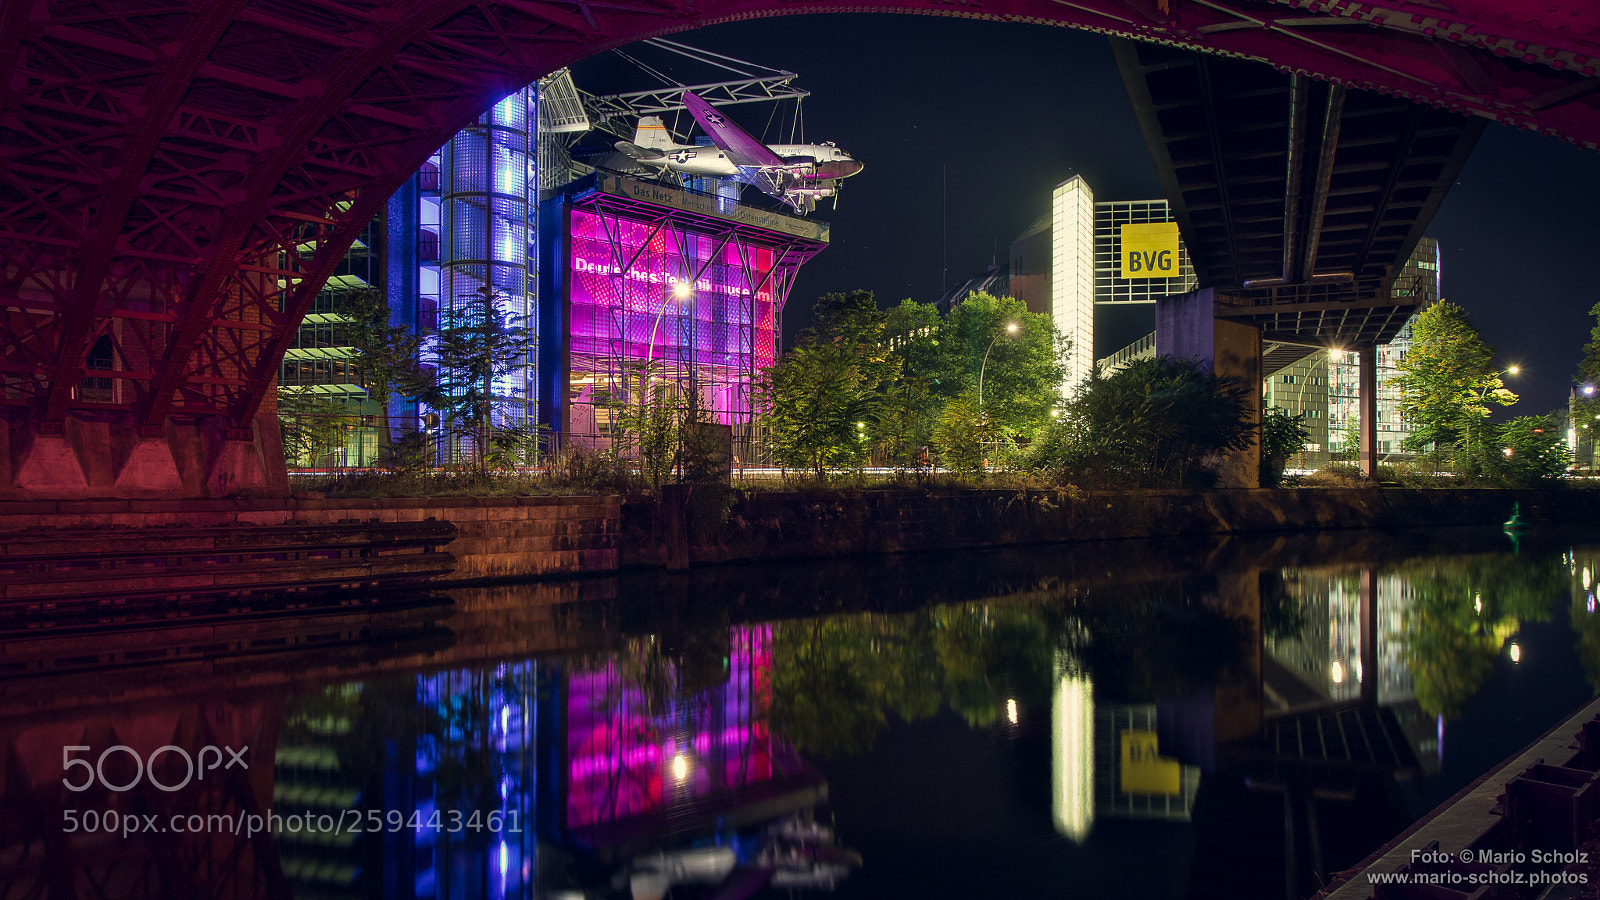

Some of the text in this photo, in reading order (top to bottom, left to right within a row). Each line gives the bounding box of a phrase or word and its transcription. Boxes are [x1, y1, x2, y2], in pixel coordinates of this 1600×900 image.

[634, 185, 650, 198] Das
[652, 189, 672, 203] Netz
[1129, 250, 1172, 272] BVG
